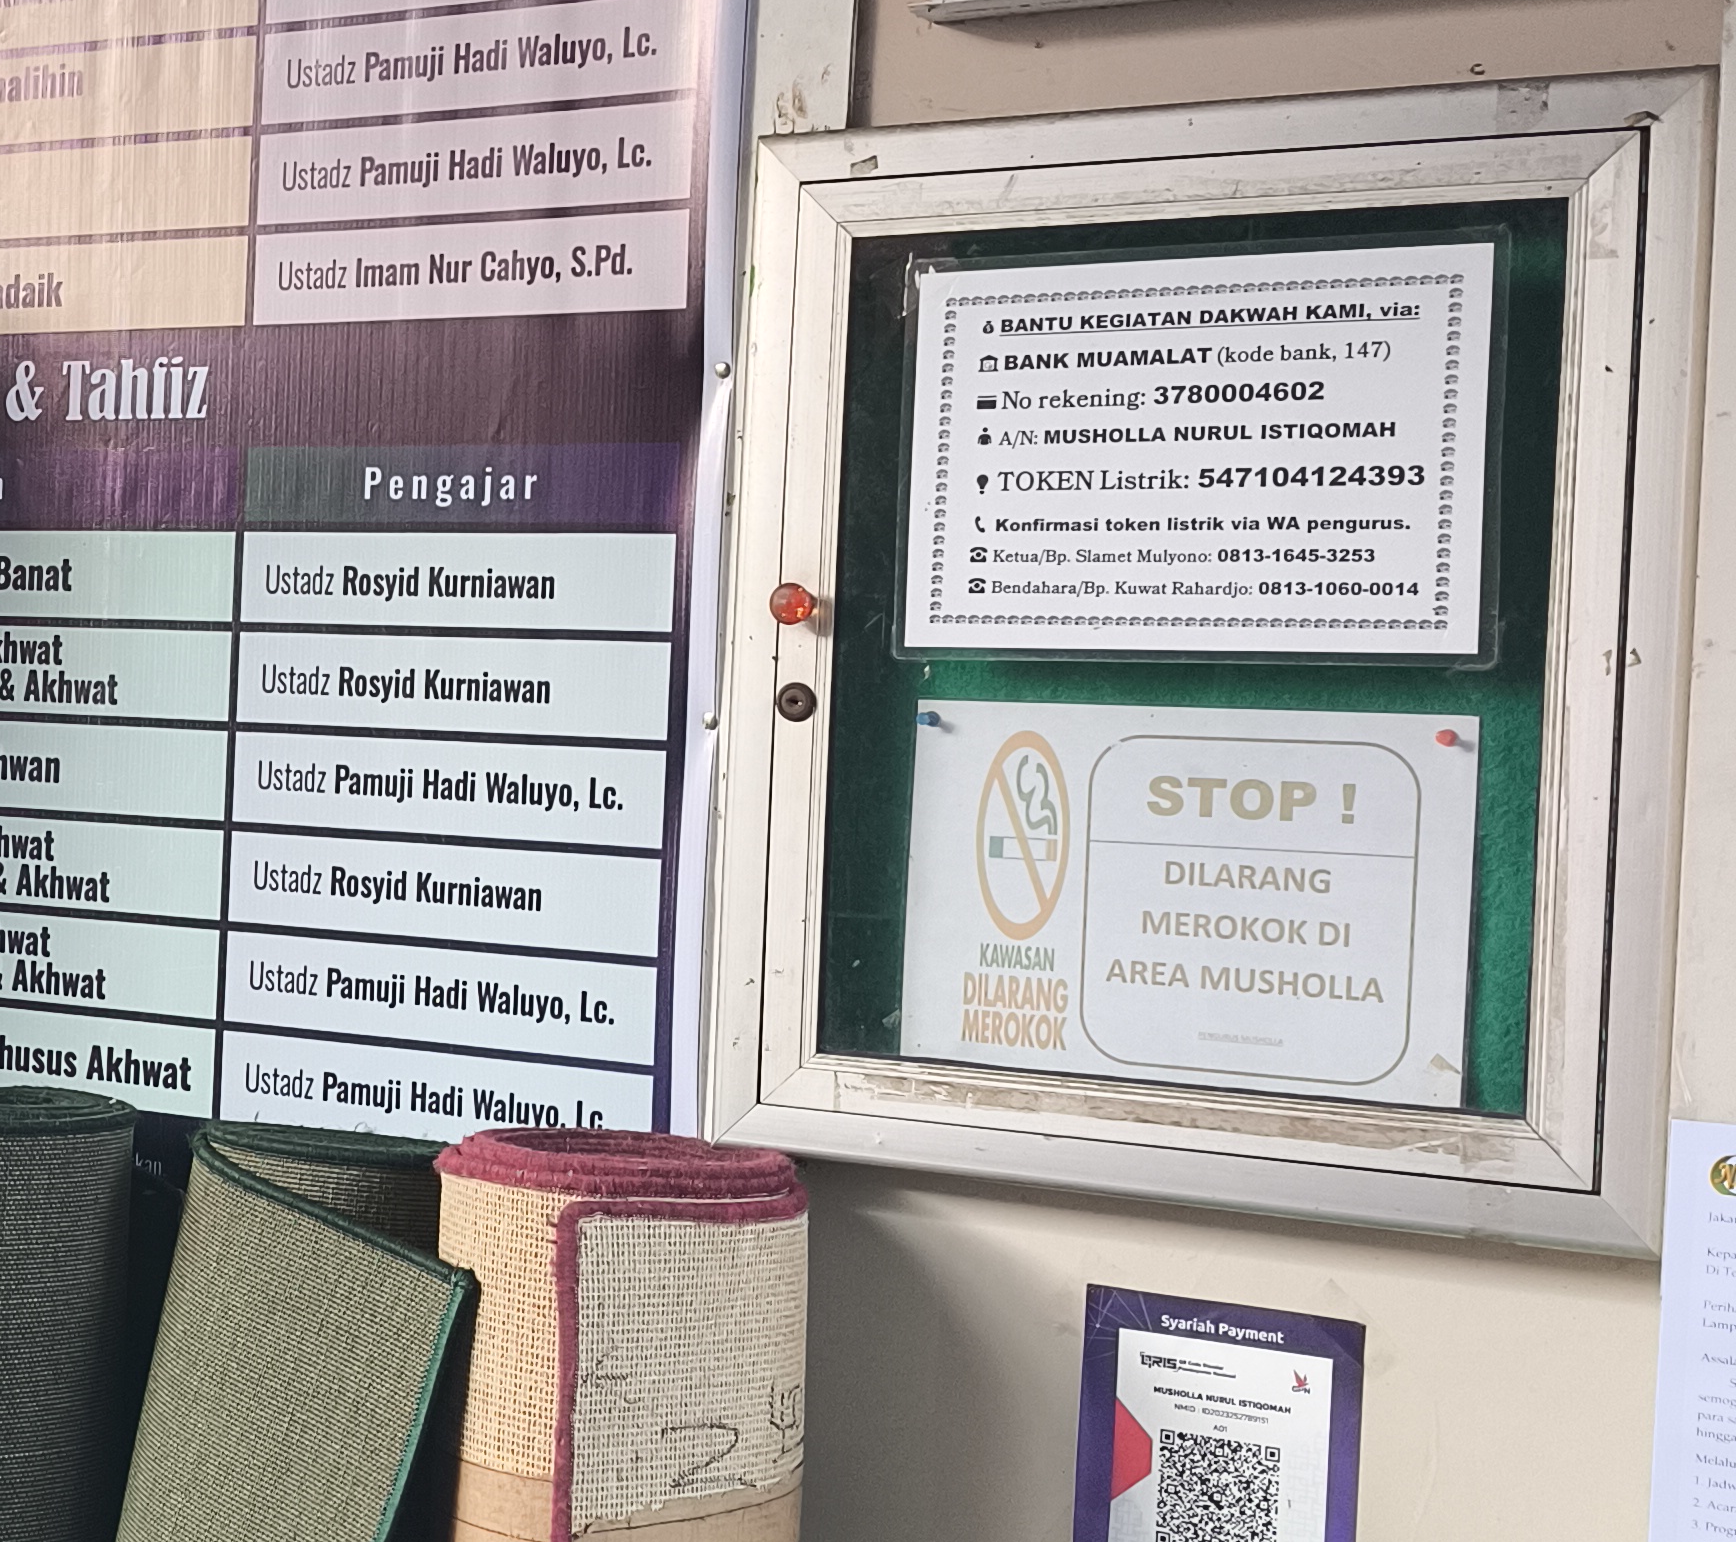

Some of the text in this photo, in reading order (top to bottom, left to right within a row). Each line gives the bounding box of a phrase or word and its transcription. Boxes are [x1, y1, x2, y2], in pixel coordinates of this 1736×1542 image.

[1000, 301, 1421, 333] BANTU KEGIATAN DAKWAH KAMI, via:
[1004, 340, 1391, 371] BANK MUAMALAT (kode bank, 147)
[5, 360, 45, 422] &
[62, 355, 210, 421] Tahfiz
[1001, 380, 1325, 411] No rekening: 3780004602
[998, 421, 1396, 450] A/N: MUSHOLLA NURUL ISTIQOMAH
[364, 466, 538, 508] Pengajar
[997, 464, 1425, 492] TOKEN Listrik: 547104124393
[995, 516, 1411, 534] Konfirmasi token listrik via WA pengurus.
[992, 548, 1375, 566] Ketua/Bp. Slamet Mulyono: 0813-1645-3253
[991, 580, 1420, 599] Bendahara/Bp. Kuwat Rahardjo: 0813-1060-0014
[1146, 775, 1357, 825] STOP !
[1164, 860, 1332, 894] DILARANG
[1141, 910, 1351, 948] MEROKOK DI
[979, 942, 1055, 973] KAWASAN
[962, 974, 1067, 1014] DILARANG
[1105, 958, 1385, 1004] AREA MUSHOLLA
[961, 1009, 1065, 1050] MEROKOK
[85, 1044, 192, 1092] Akhwat
[1161, 1314, 1285, 1344] Syariah Payment
[1153, 1385, 1292, 1415] MUSHOLLA NURUL ISTIQOMAH
